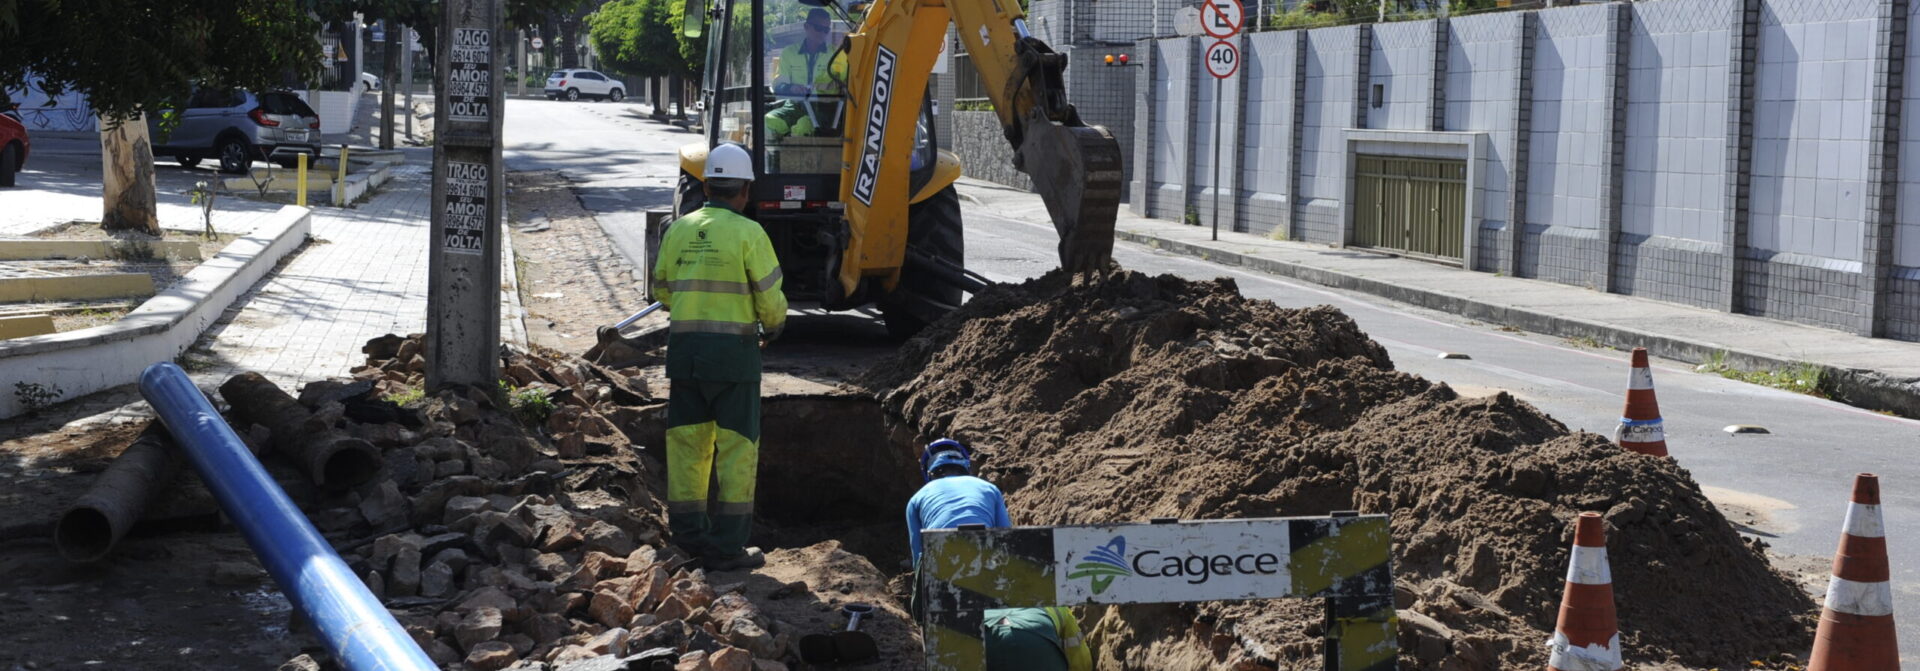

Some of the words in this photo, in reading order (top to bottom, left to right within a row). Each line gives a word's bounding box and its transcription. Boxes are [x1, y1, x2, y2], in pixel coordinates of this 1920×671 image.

[1215, 4, 1229, 27] E
[455, 30, 489, 46] RAGO
[472, 51, 489, 63] 6071
[1211, 48, 1233, 64] 40
[450, 69, 488, 82] AMOR
[449, 102, 488, 116] VOLTA
[857, 54, 892, 197] RANDON
[447, 163, 487, 180] TRAGO
[469, 184, 487, 197] 6071
[446, 202, 485, 216] AMOR
[444, 234, 482, 249] VOLTA
[1132, 549, 1279, 585] Cagece
